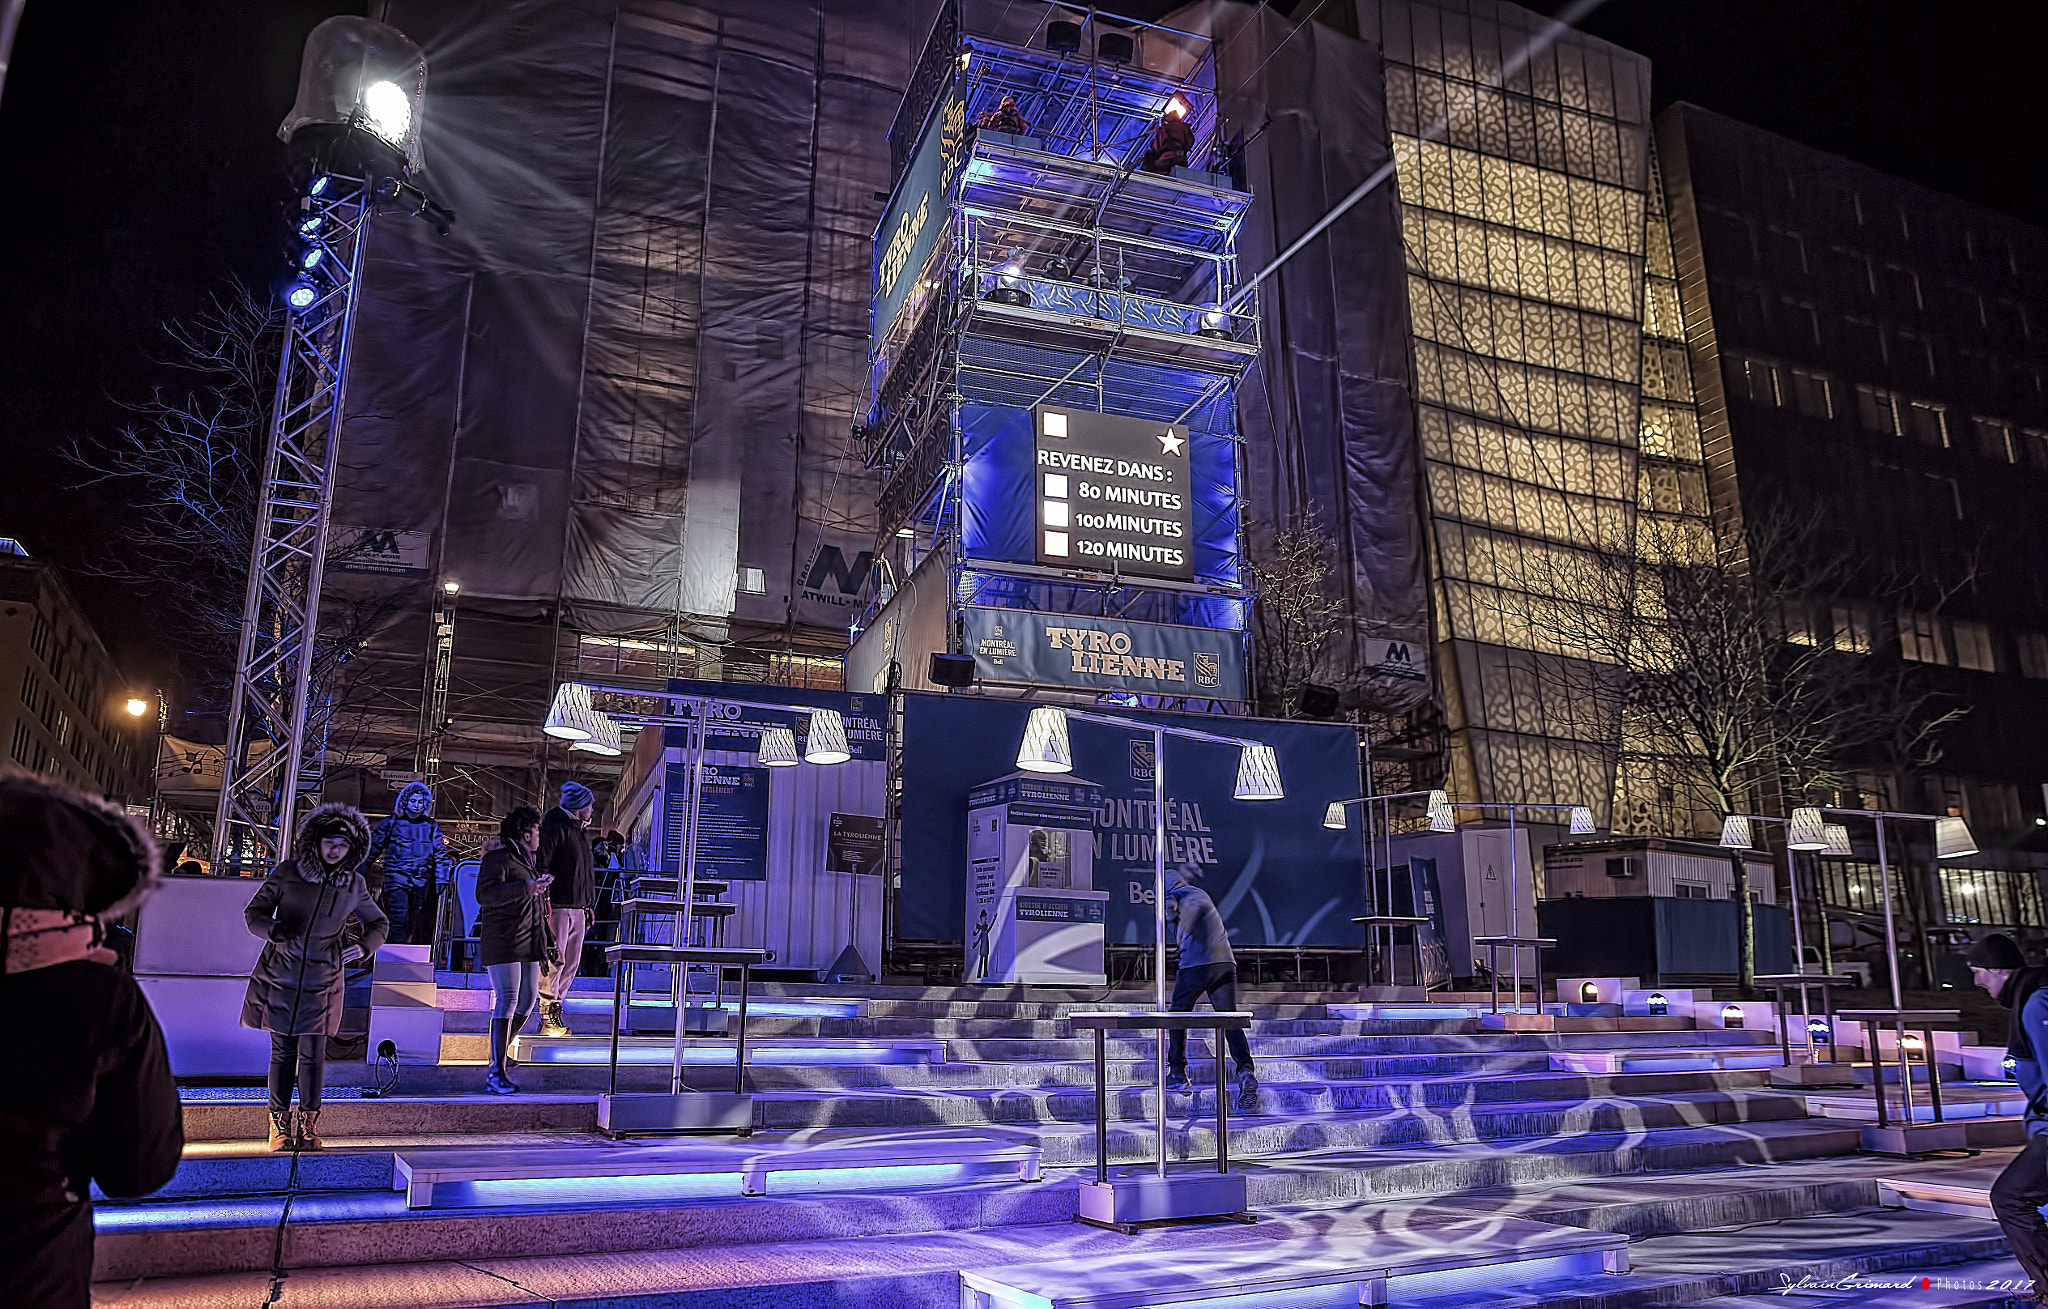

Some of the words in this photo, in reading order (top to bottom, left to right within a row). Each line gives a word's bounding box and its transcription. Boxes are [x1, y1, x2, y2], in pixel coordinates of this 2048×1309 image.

[940, 142, 963, 198] RBC
[879, 211, 910, 287] TYRO
[886, 190, 929, 300] LIENNE
[1038, 450, 1114, 475] REVENEZ
[1079, 482, 1101, 499] 80
[1105, 485, 1182, 510] MINUTES
[1075, 513, 1104, 529] 100
[1106, 513, 1183, 538] MINUTES
[1077, 541, 1104, 556] 120
[1106, 541, 1184, 566] MINUTES
[980, 638, 1016, 650] MONTRÉAL
[980, 646, 990, 655] EN
[1046, 627, 1132, 655] TYRO
[1071, 650, 1185, 682] LIENNE
[1198, 675, 1217, 686] RBC
[849, 744, 862, 754] Bell
[1021, 790, 1070, 801] TYROLIENNE
[842, 831, 882, 841] TYROLIENNE
[1129, 881, 1156, 905] Be
[1020, 909, 1069, 918] TYROLIENNE
